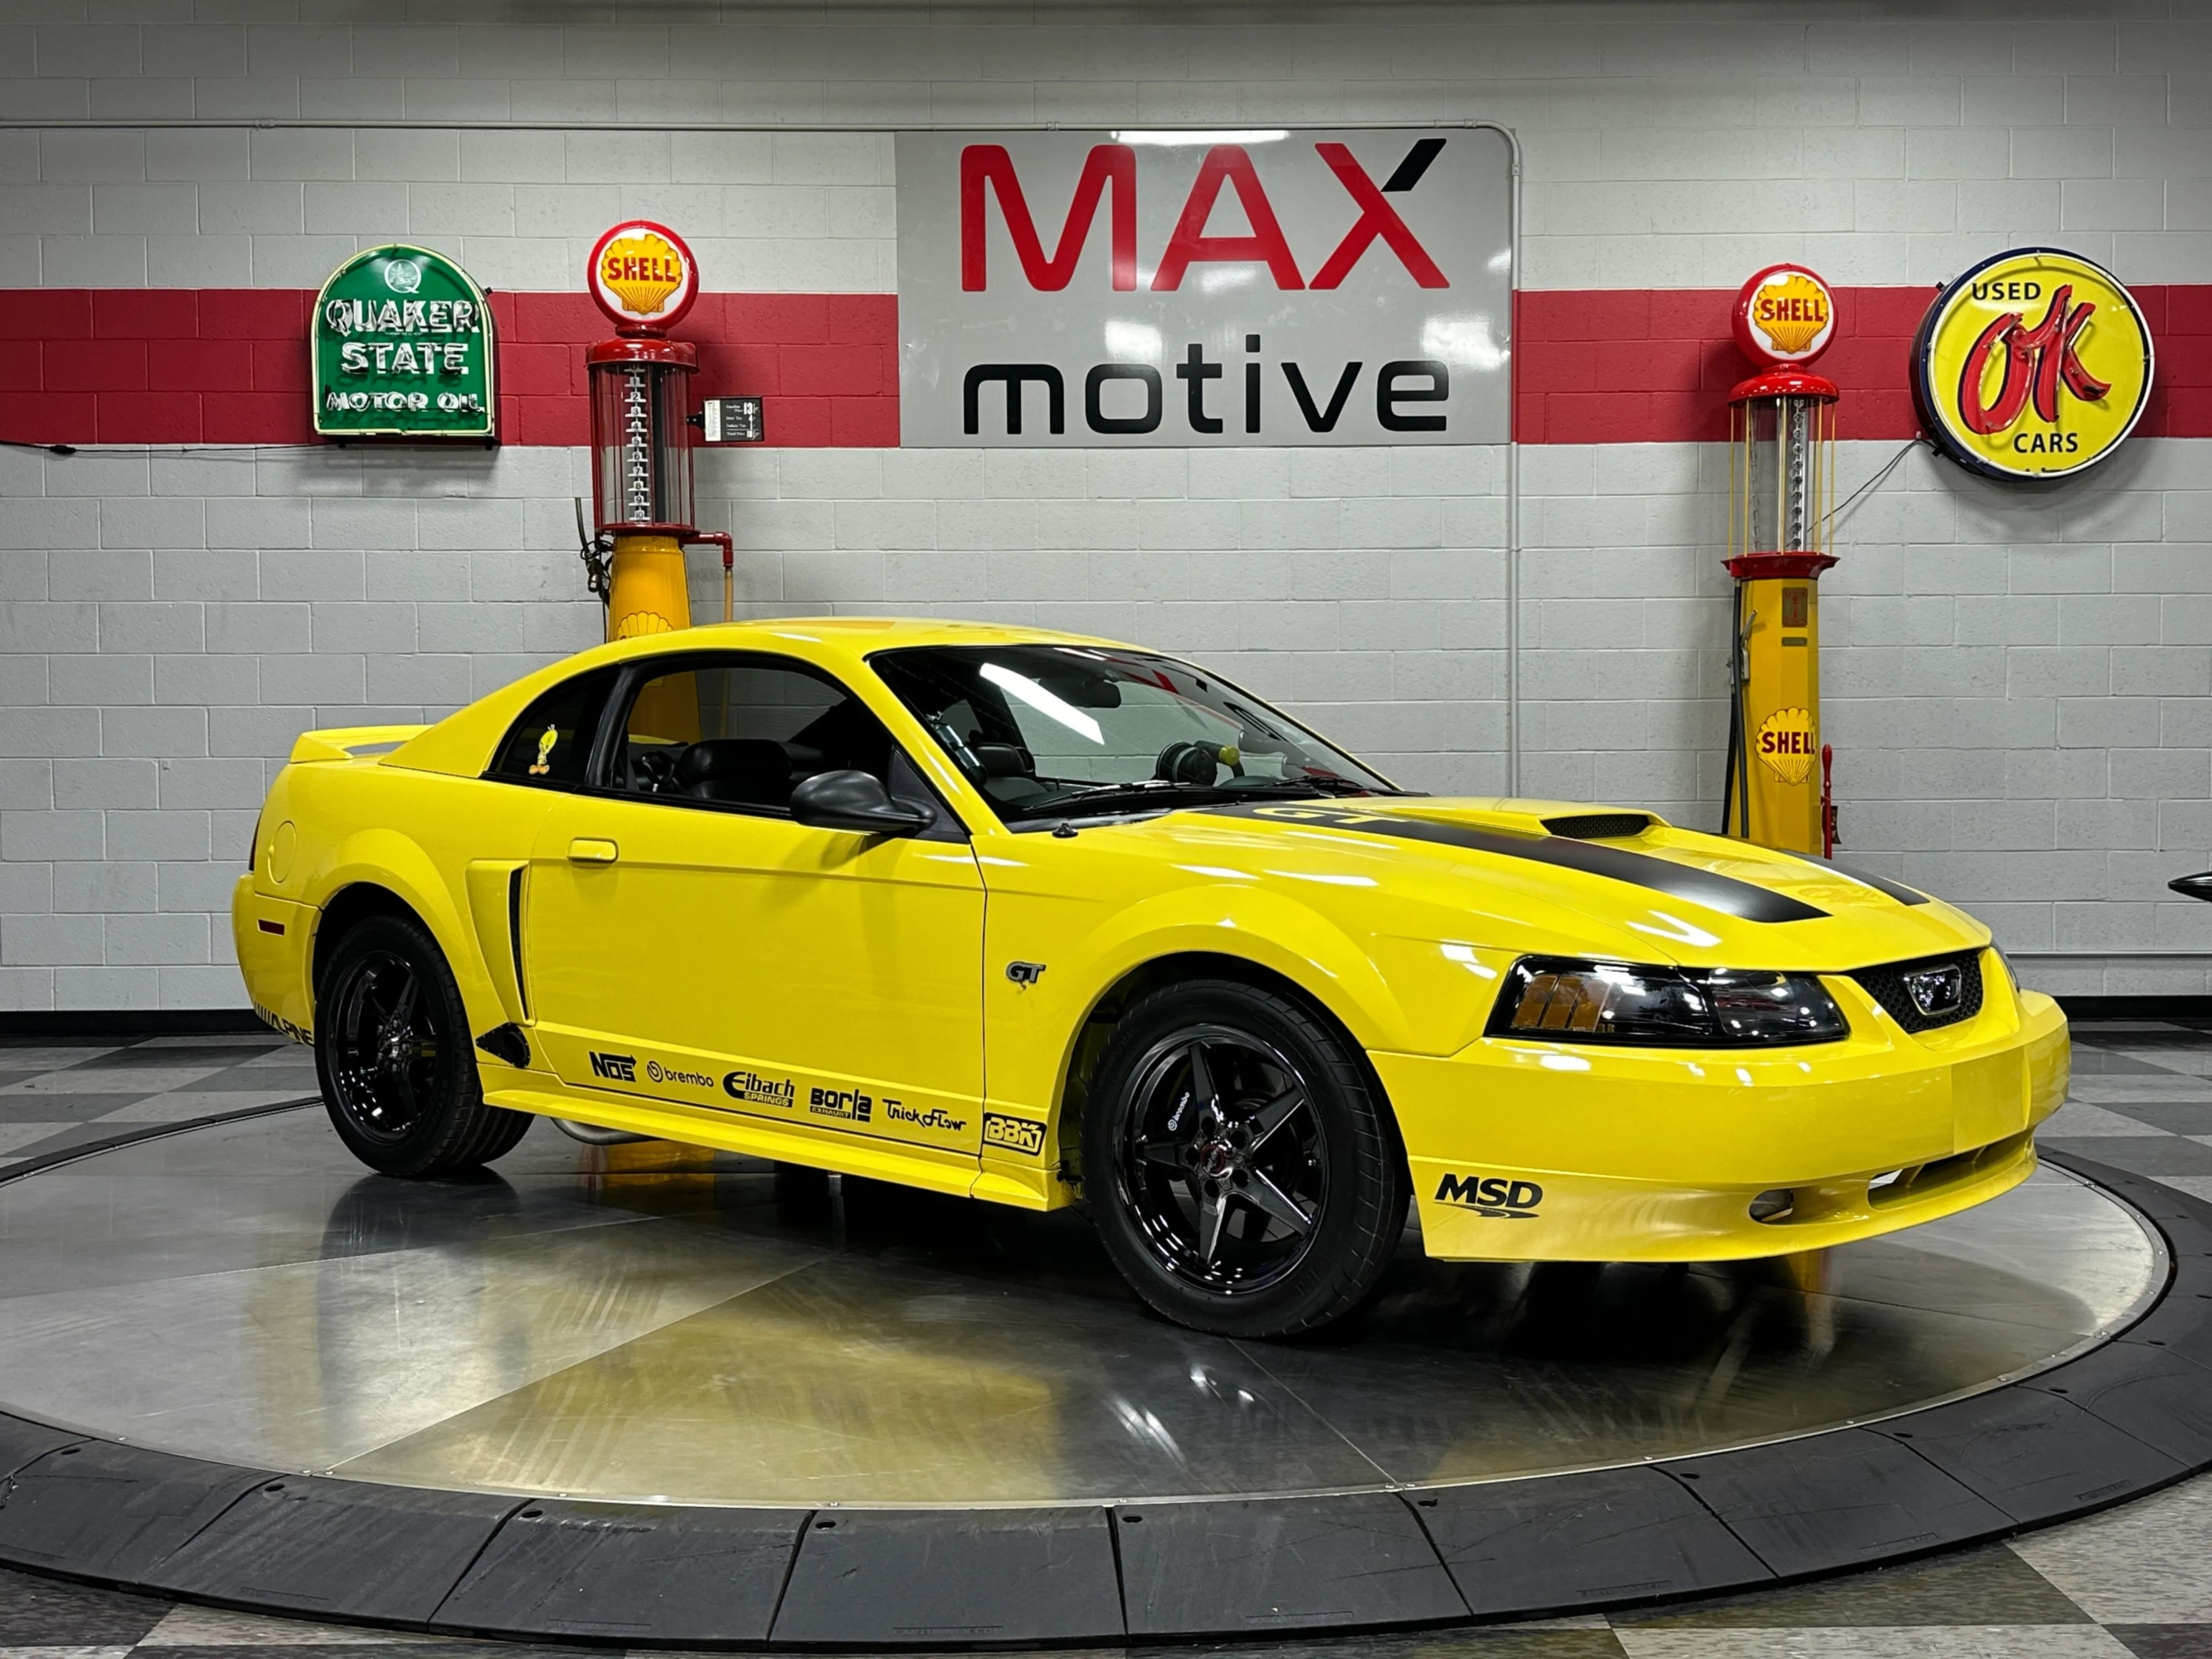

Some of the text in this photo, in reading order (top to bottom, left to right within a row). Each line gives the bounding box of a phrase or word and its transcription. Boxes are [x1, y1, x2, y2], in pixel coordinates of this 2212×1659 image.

[960, 139, 1451, 292] MAX
[607, 256, 678, 283] SHELL
[1971, 282, 2042, 301] USED
[326, 299, 480, 337] QUAKER
[1760, 298, 1824, 322] SHELL
[341, 342, 469, 375] STATE
[1958, 285, 2112, 435] OK
[633, 392, 639, 401] 2
[963, 334, 1450, 435] motive
[326, 392, 485, 412] MOTOR OIL
[633, 407, 639, 416] 3
[2013, 432, 2079, 454] CARS
[634, 452, 640, 460] 6
[635, 467, 640, 475] 7
[635, 482, 641, 490] 8
[635, 511, 644, 519] 10
[1761, 731, 1816, 755] SHELL
[1252, 807, 1411, 825] GT
[1006, 961, 1047, 985] GT
[589, 1051, 637, 1082] NOS
[664, 1067, 714, 1087] brembo
[722, 1071, 795, 1099] Eibach
[743, 1092, 790, 1107] SPRINGS
[988, 1117, 1040, 1148] BBK
[1434, 1173, 1544, 1209] MSD
